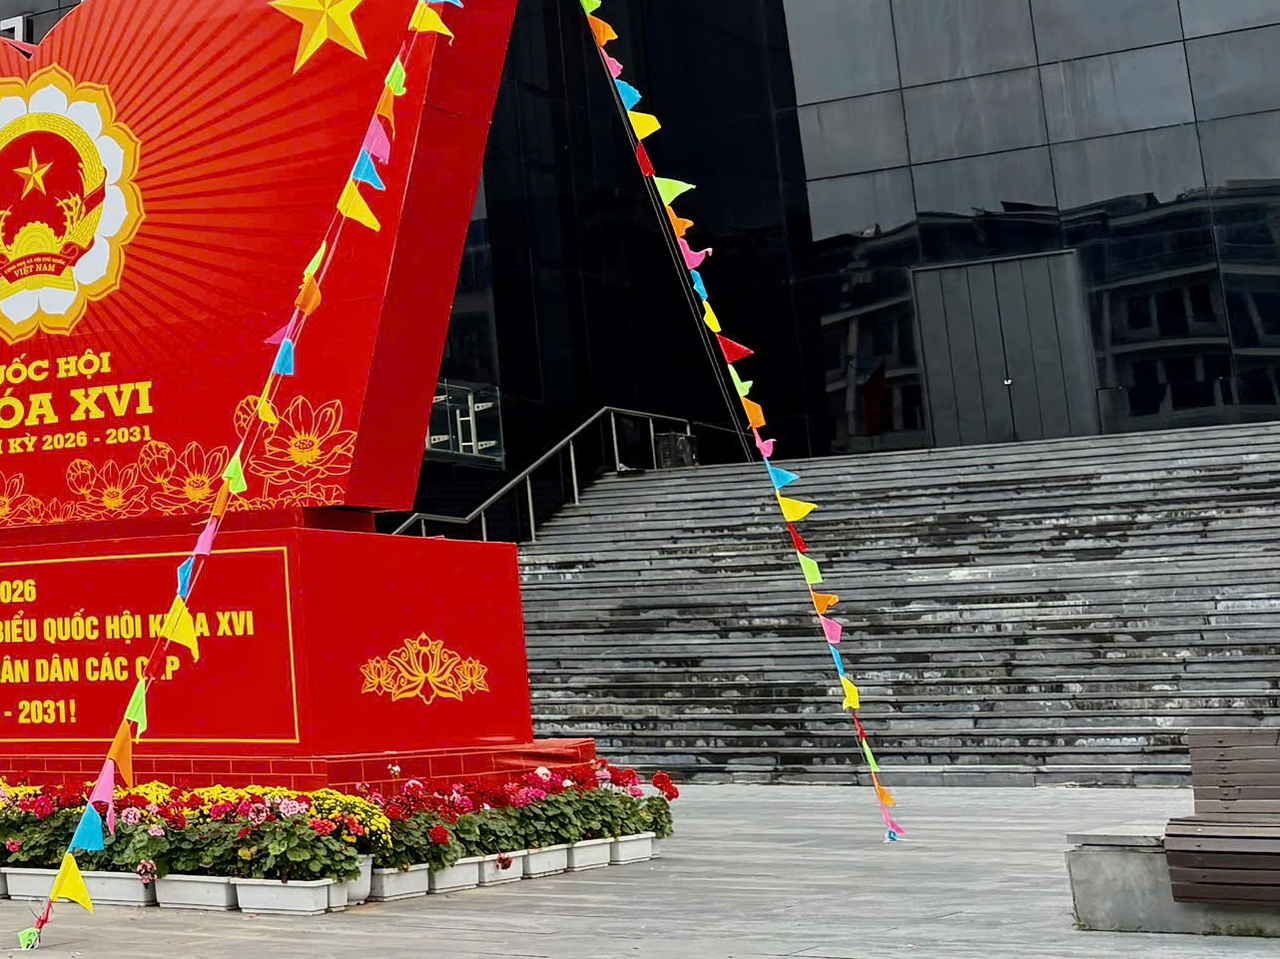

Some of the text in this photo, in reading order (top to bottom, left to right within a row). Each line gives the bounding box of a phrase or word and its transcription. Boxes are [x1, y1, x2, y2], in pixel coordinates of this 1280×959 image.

[14, 265, 34, 277] VIỆT
[36, 263, 56, 272] NAM
[57, 349, 111, 379] HỘI
[70, 381, 153, 421] XVI
[8, 433, 37, 453] KỲ
[42, 431, 87, 450] 2026
[106, 425, 151, 444] 2031
[44, 609, 99, 643] QUỐC
[106, 610, 142, 644] HỘI
[149, 607, 210, 638] KA
[216, 611, 254, 636] XVI
[36, 654, 79, 682] DÂN
[86, 652, 128, 681] CÁC
[135, 655, 180, 681] CP
[19, 699, 76, 723] 2031!
